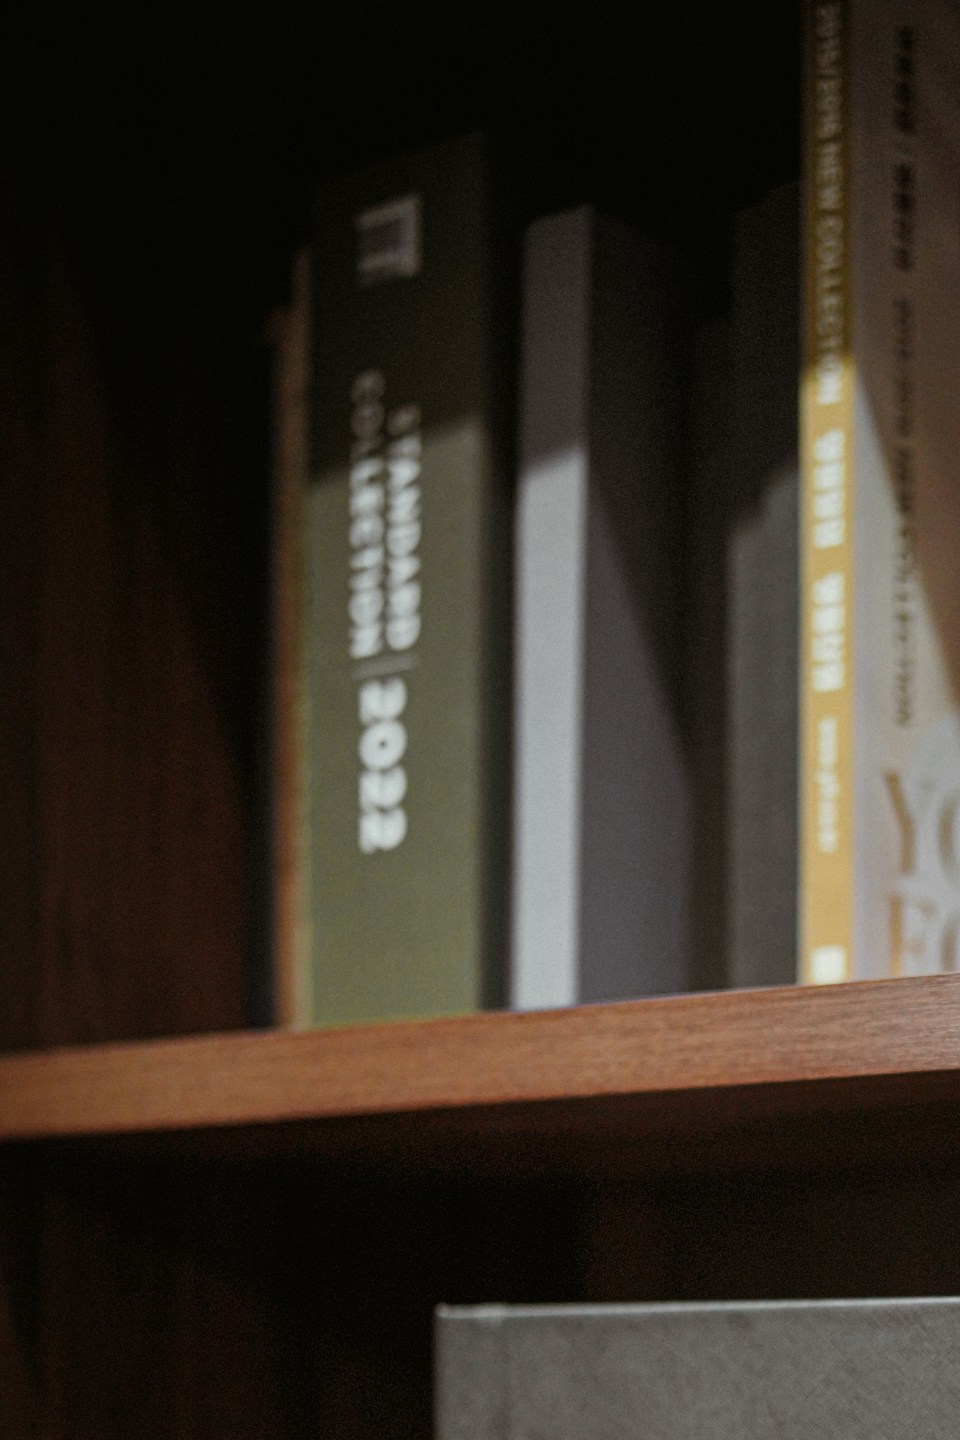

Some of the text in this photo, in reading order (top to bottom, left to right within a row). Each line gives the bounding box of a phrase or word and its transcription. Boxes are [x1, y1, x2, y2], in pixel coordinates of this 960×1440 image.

[814, 216, 845, 404] COLLECTION
[349, 370, 386, 658] COLLECTION
[386, 404, 422, 652] STANDARD
[358, 678, 408, 855] 2022
